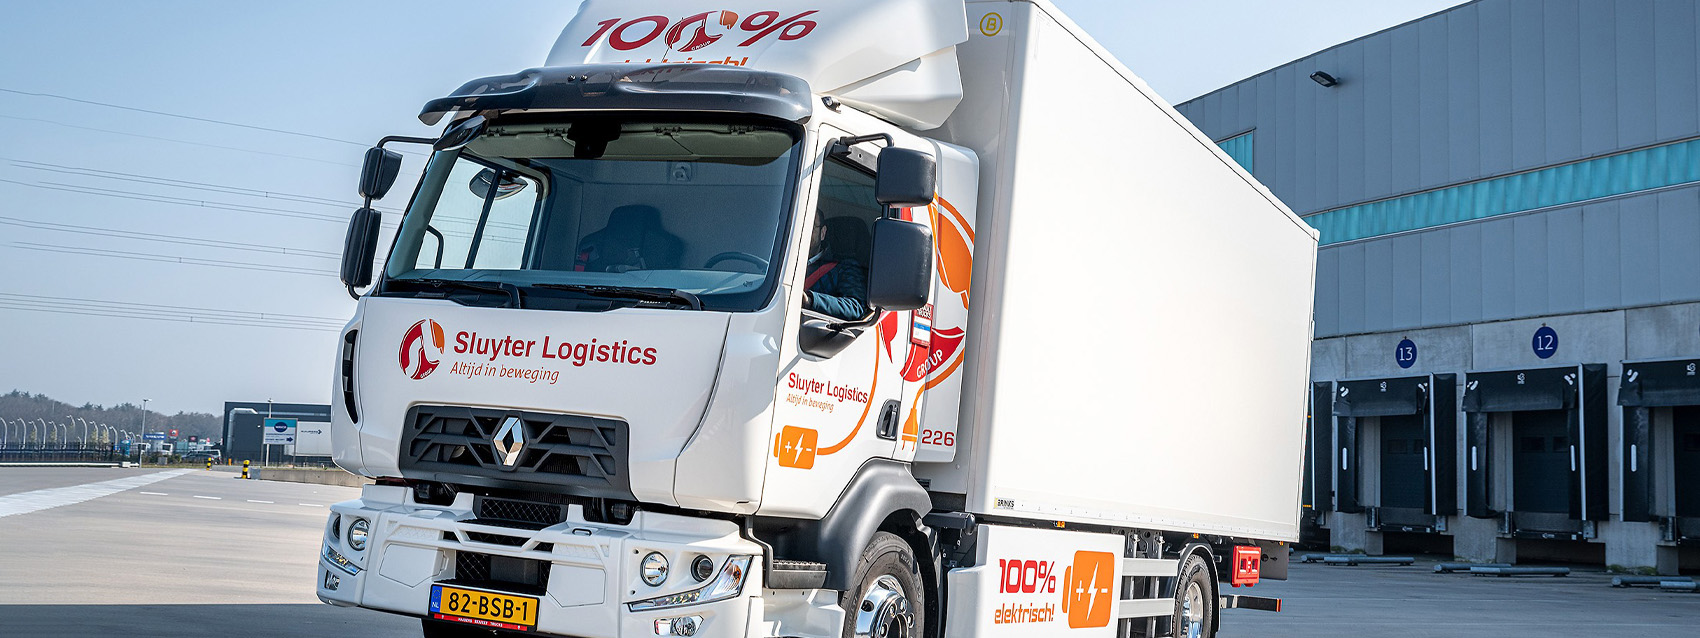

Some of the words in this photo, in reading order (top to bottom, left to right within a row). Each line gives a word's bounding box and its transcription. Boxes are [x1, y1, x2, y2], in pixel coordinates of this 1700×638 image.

[453, 331, 536, 362] Sluyter
[542, 335, 658, 367] Logistics
[1399, 346, 1413, 361] 13
[1537, 335, 1554, 351] 12
[450, 361, 483, 377] Altijd
[484, 363, 497, 377] in
[499, 365, 560, 384] beweging
[916, 349, 943, 378] GROUP
[788, 372, 825, 395] Sluyter
[827, 381, 868, 403] Logistics
[786, 394, 802, 406] Altijd
[802, 396, 808, 405] in
[808, 397, 834, 413] beweging
[922, 429, 955, 446] 226
[999, 559, 1056, 593] 100%
[431, 601, 439, 609] NL
[448, 592, 528, 621] 82-BSB-1
[994, 602, 1055, 624] elektrisch!
